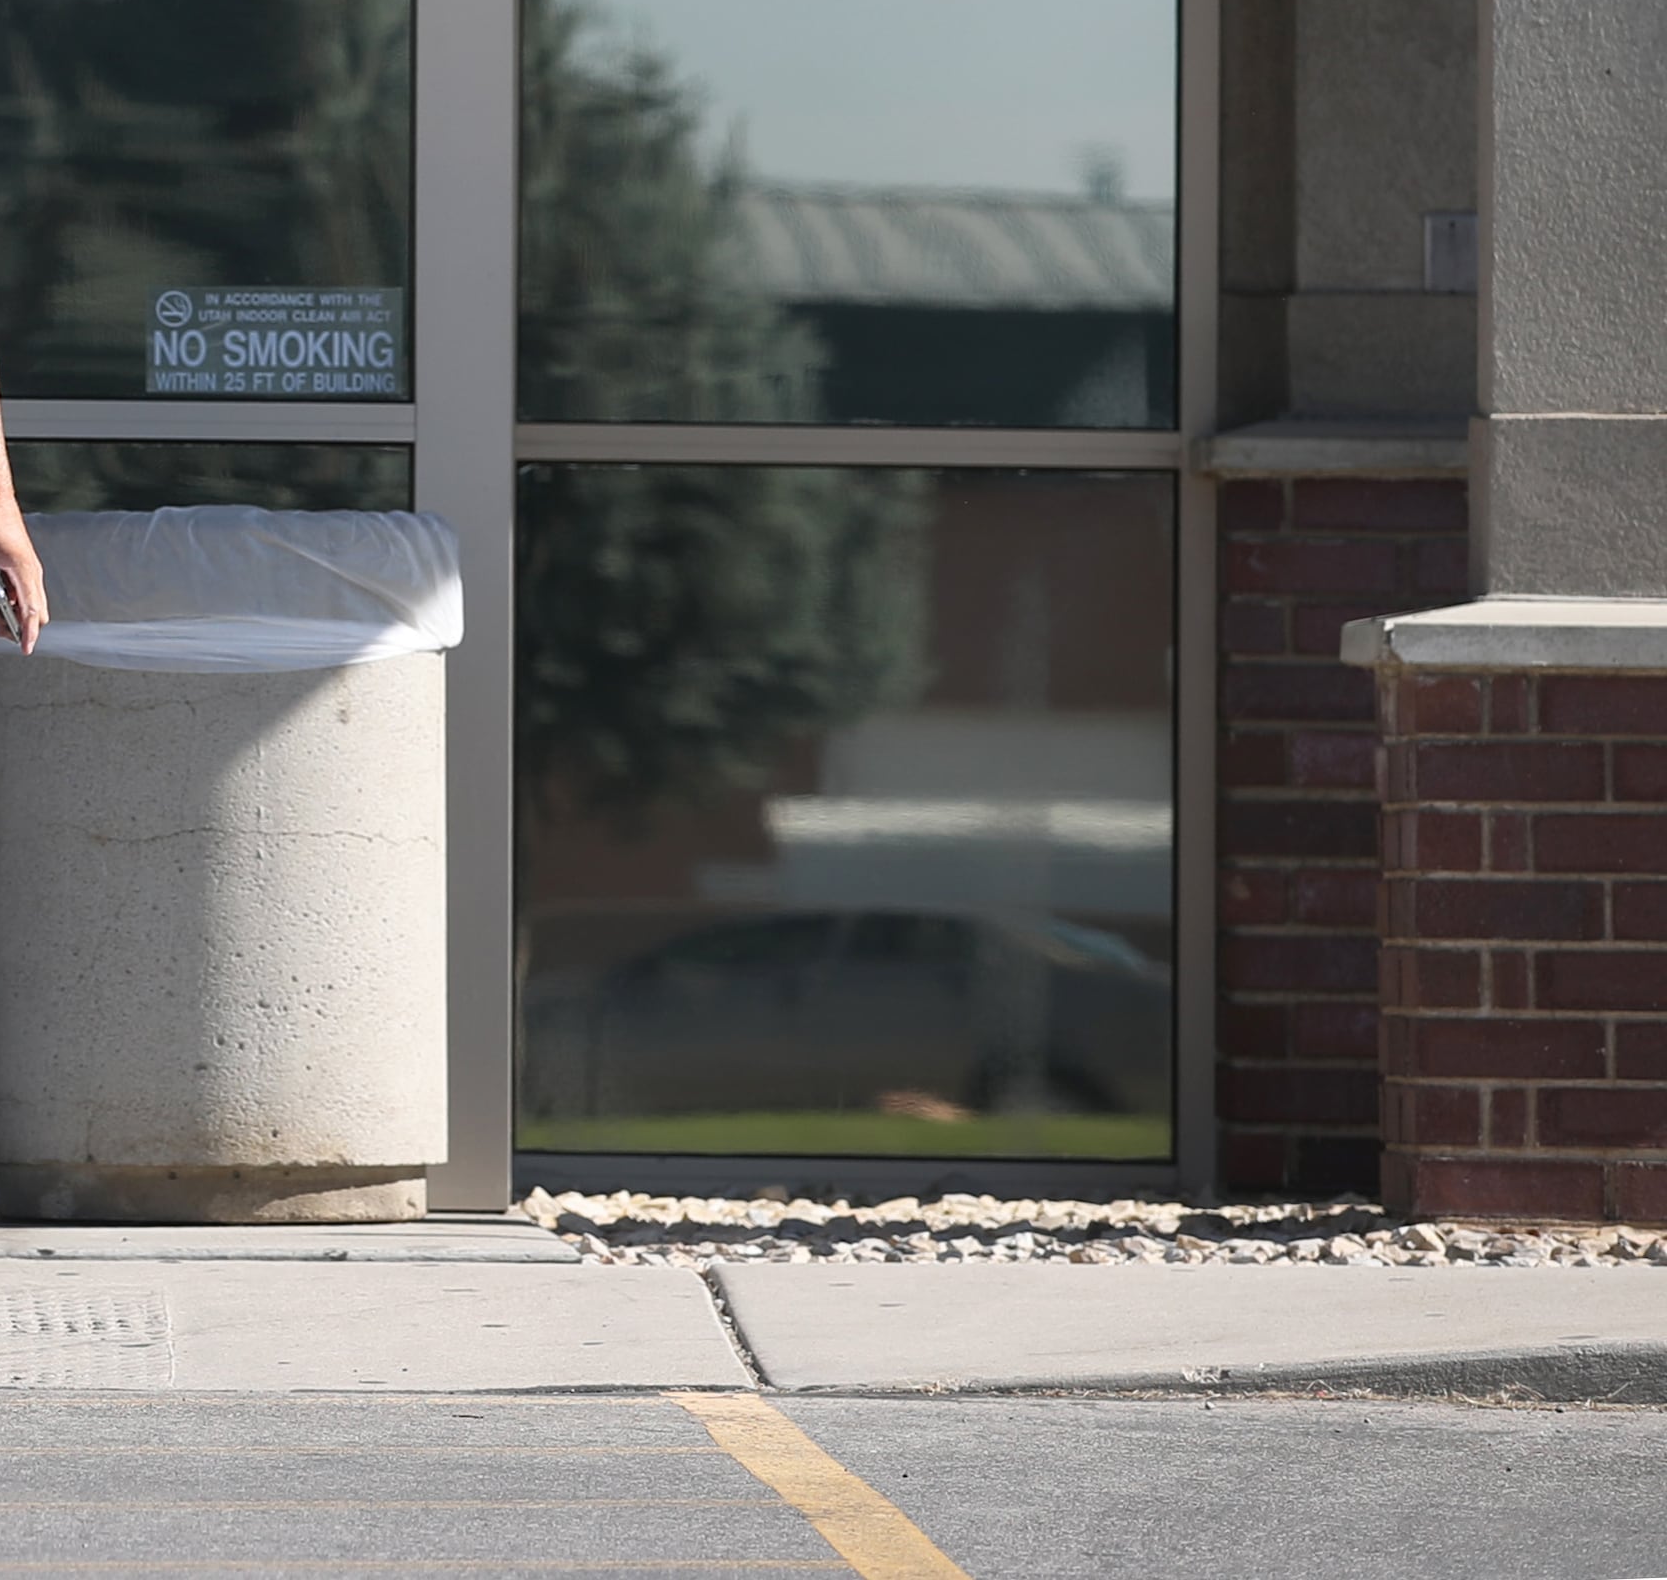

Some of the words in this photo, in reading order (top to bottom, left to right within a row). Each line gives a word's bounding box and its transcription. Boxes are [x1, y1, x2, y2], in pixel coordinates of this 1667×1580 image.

[205, 293, 219, 306] IN
[223, 293, 315, 307] ACCORDANCE
[320, 293, 353, 307] WITH
[358, 294, 383, 307] THE
[198, 309, 231, 322] UTAH
[236, 310, 288, 323] INDOOR
[292, 310, 335, 323] CLEAN
[341, 310, 362, 323] AIR
[367, 310, 392, 323] ACT
[153, 329, 208, 367] NO
[222, 329, 395, 368] SMOKING
[154, 372, 217, 391] WITHIN
[223, 372, 246, 392] 25
[253, 372, 275, 392] FT
[282, 372, 307, 392] OF
[315, 372, 395, 392] BUILDING
